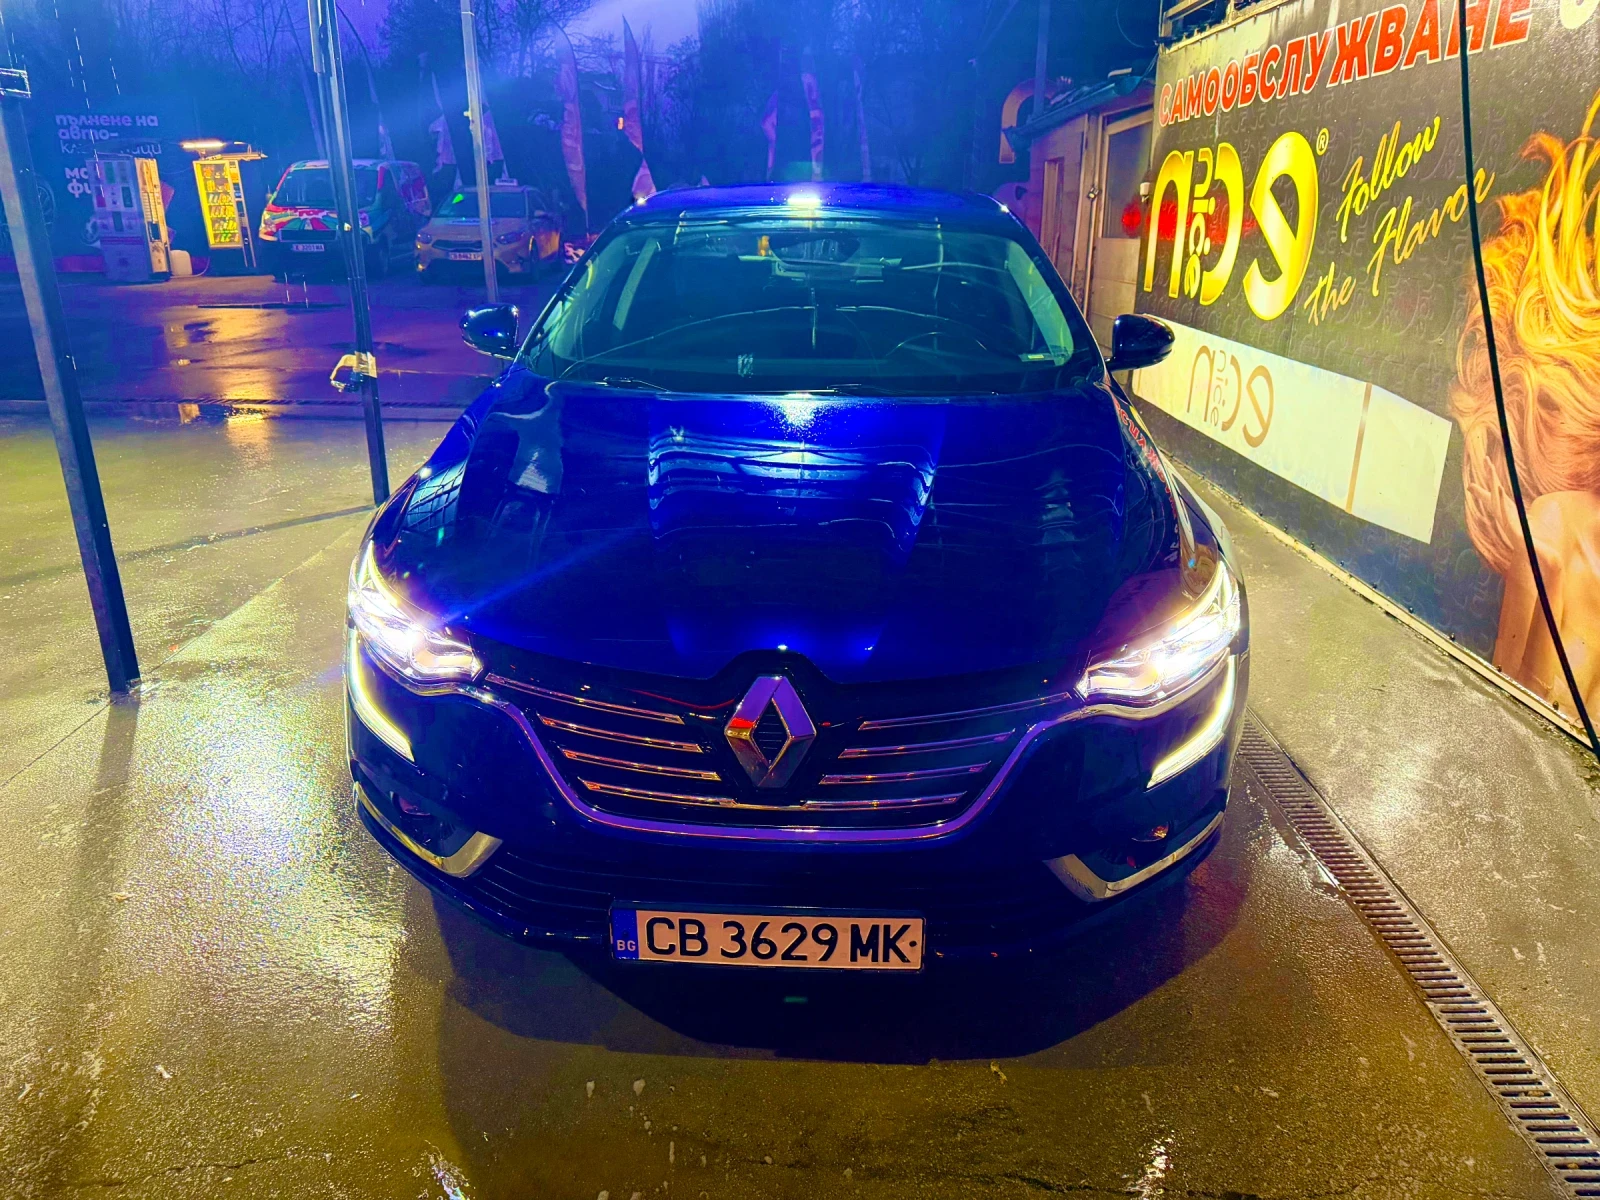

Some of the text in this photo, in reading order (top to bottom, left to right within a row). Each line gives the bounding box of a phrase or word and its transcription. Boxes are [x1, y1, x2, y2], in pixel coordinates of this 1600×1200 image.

[1158, 0, 1533, 128] САМООБСЛУЖВАНЕ
[55, 115, 159, 127] пълнене на
[1335, 116, 1441, 243] Follow
[1303, 167, 1496, 326] the Flavor
[616, 939, 636, 952] BG
[646, 916, 911, 963] CB 3629 MK
